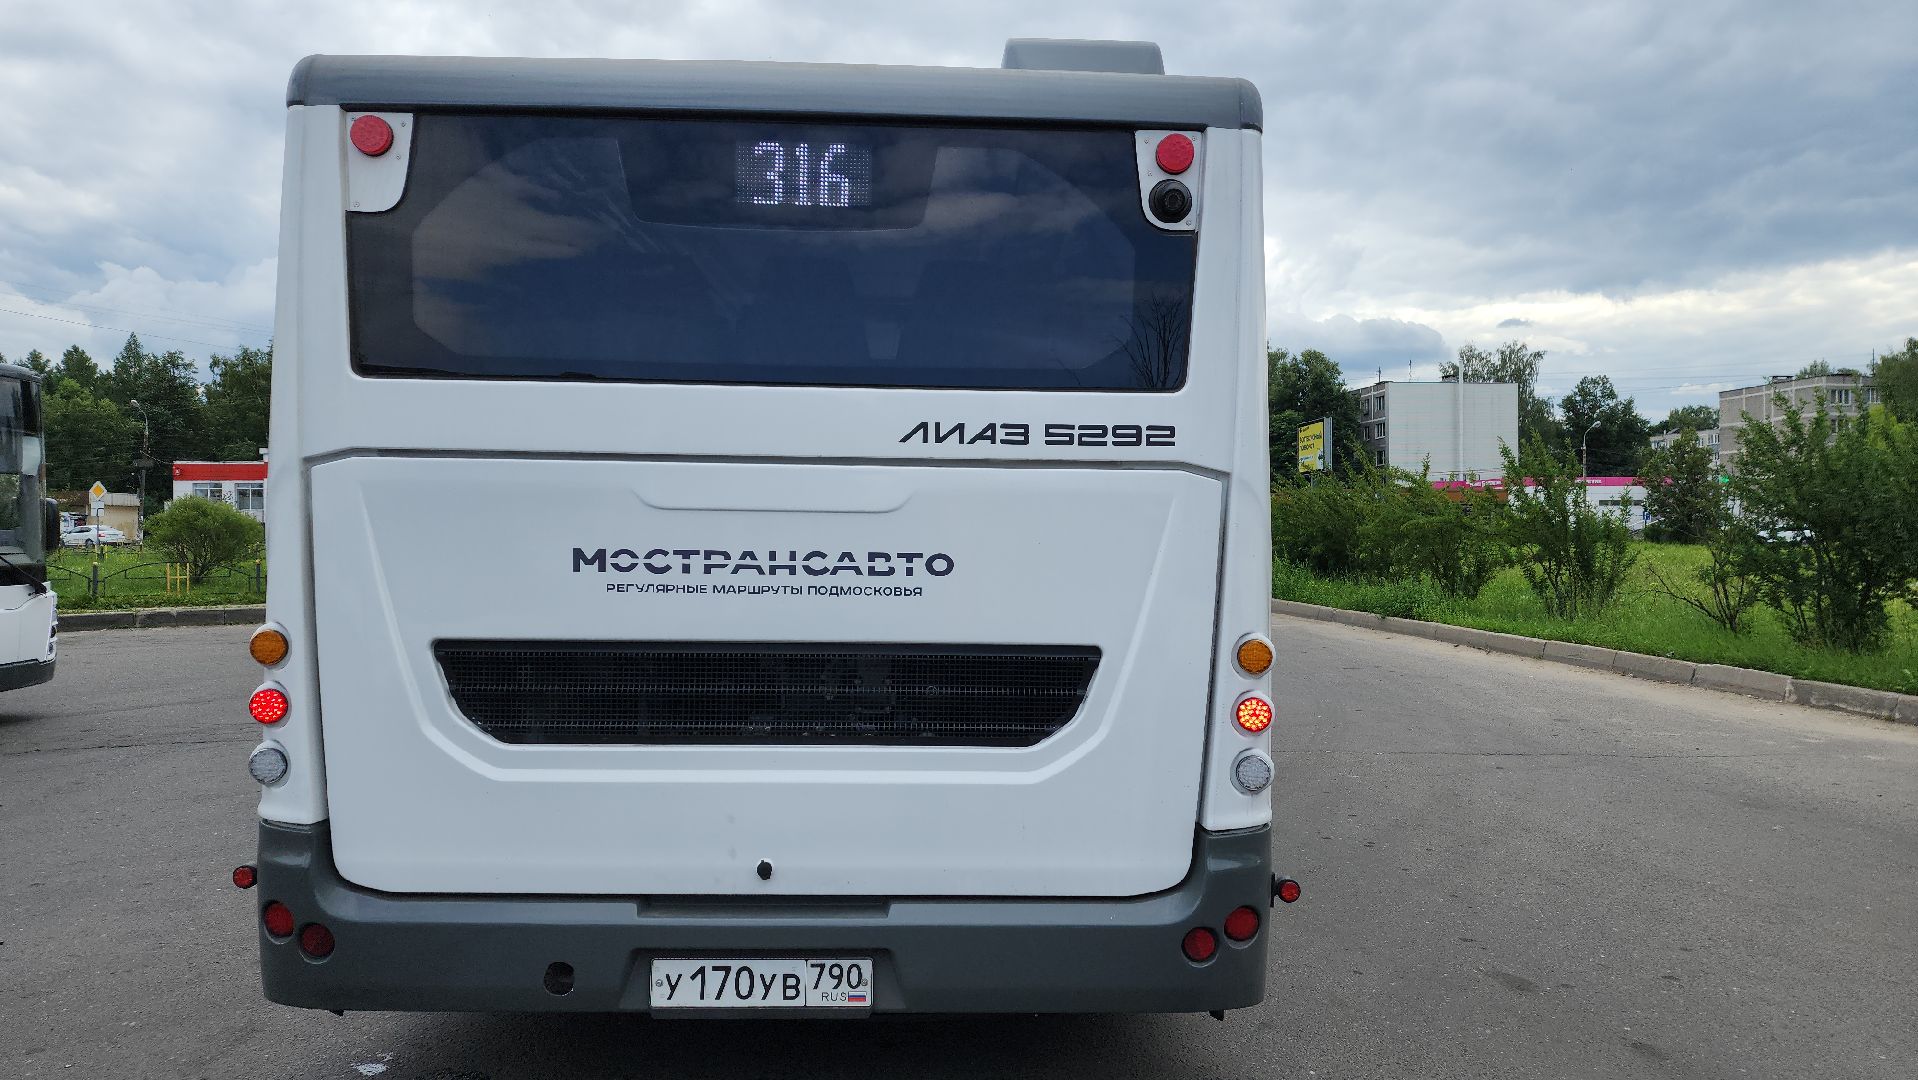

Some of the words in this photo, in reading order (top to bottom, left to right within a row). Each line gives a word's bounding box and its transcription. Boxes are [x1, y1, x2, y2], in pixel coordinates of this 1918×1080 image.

[753, 141, 849, 207] 316
[898, 421, 1030, 446] ЛИАЗ
[1044, 423, 1176, 447] 5292
[572, 547, 955, 577] МОСТРАНСАВТО
[606, 583, 708, 595] РЕГУЛЯРНЫЕ
[712, 584, 803, 596] МАРШРУТЫ
[807, 585, 923, 598] ПОДМОСКОВЬЯ
[810, 963, 863, 990] 790
[821, 991, 847, 1003] RUS
